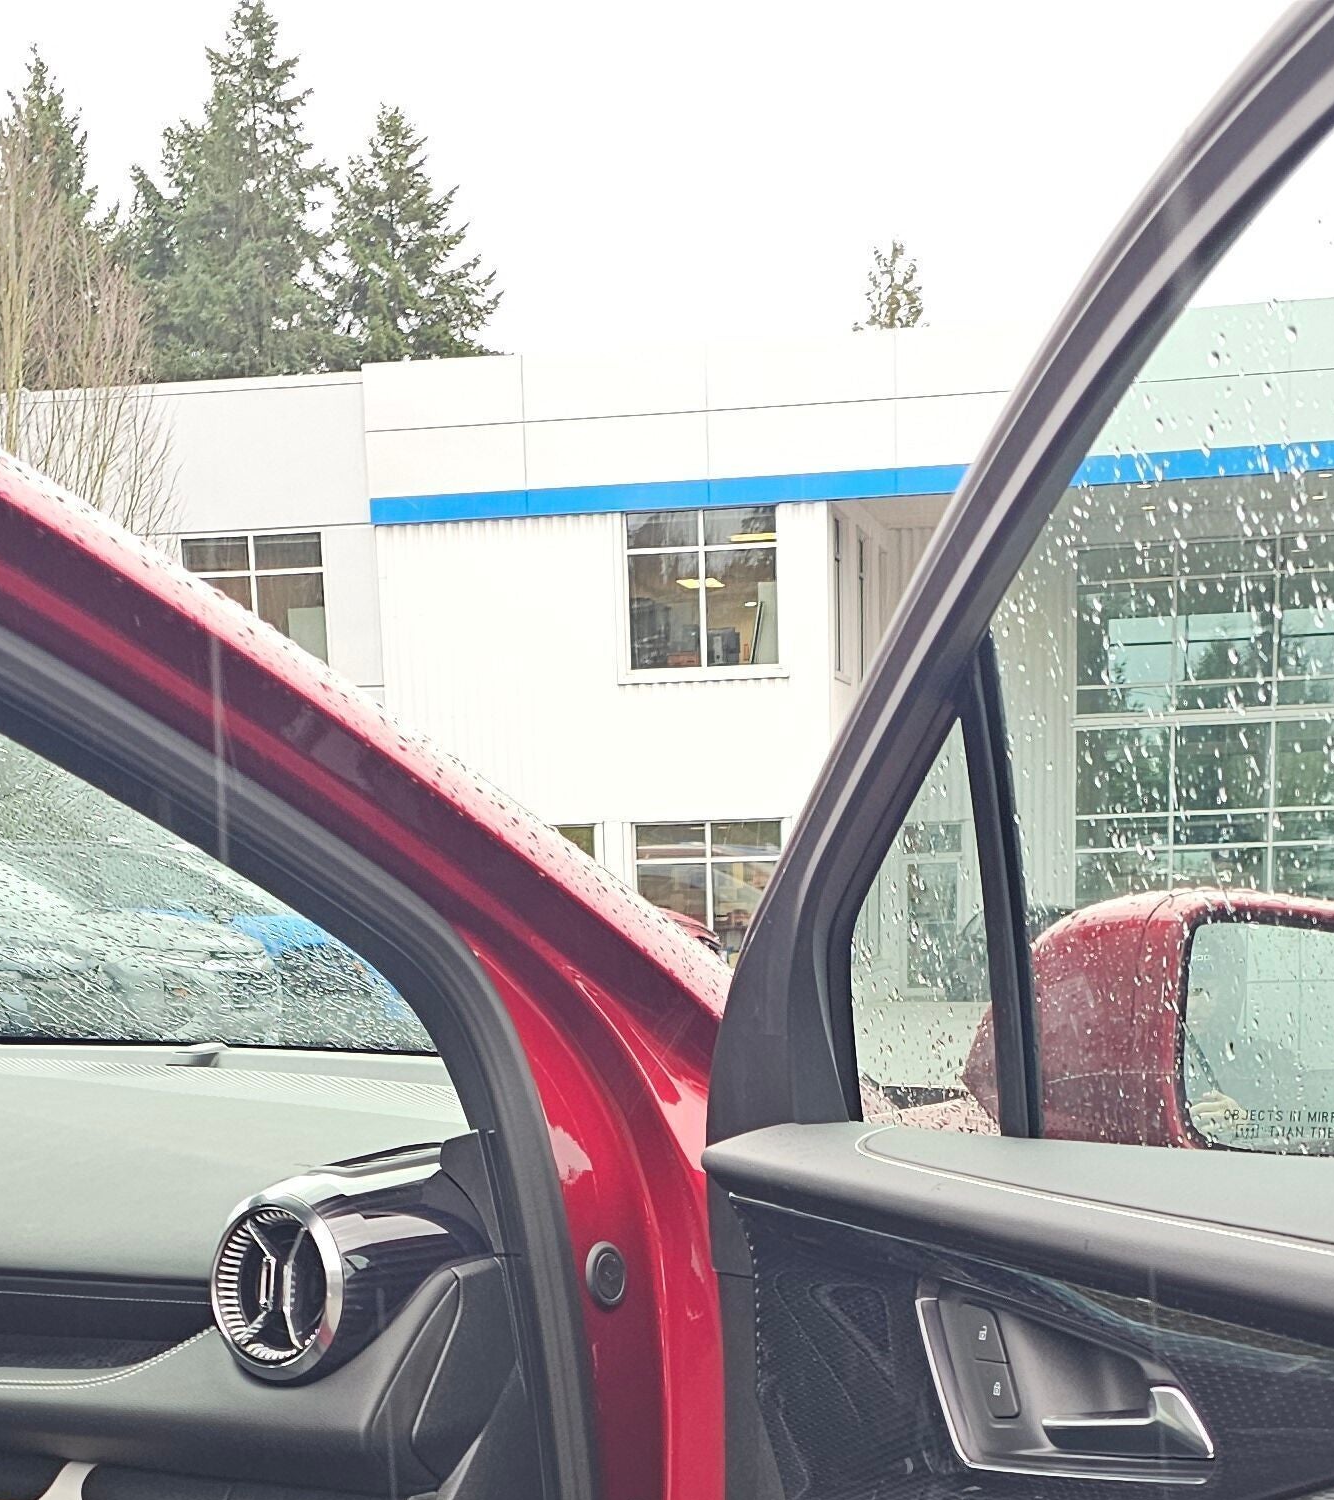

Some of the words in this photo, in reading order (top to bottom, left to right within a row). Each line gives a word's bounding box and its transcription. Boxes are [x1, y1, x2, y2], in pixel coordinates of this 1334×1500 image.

[1224, 1109, 1283, 1122] OBJECTS
[1289, 1110, 1301, 1121] IN
[1270, 1125, 1304, 1138] THAN
